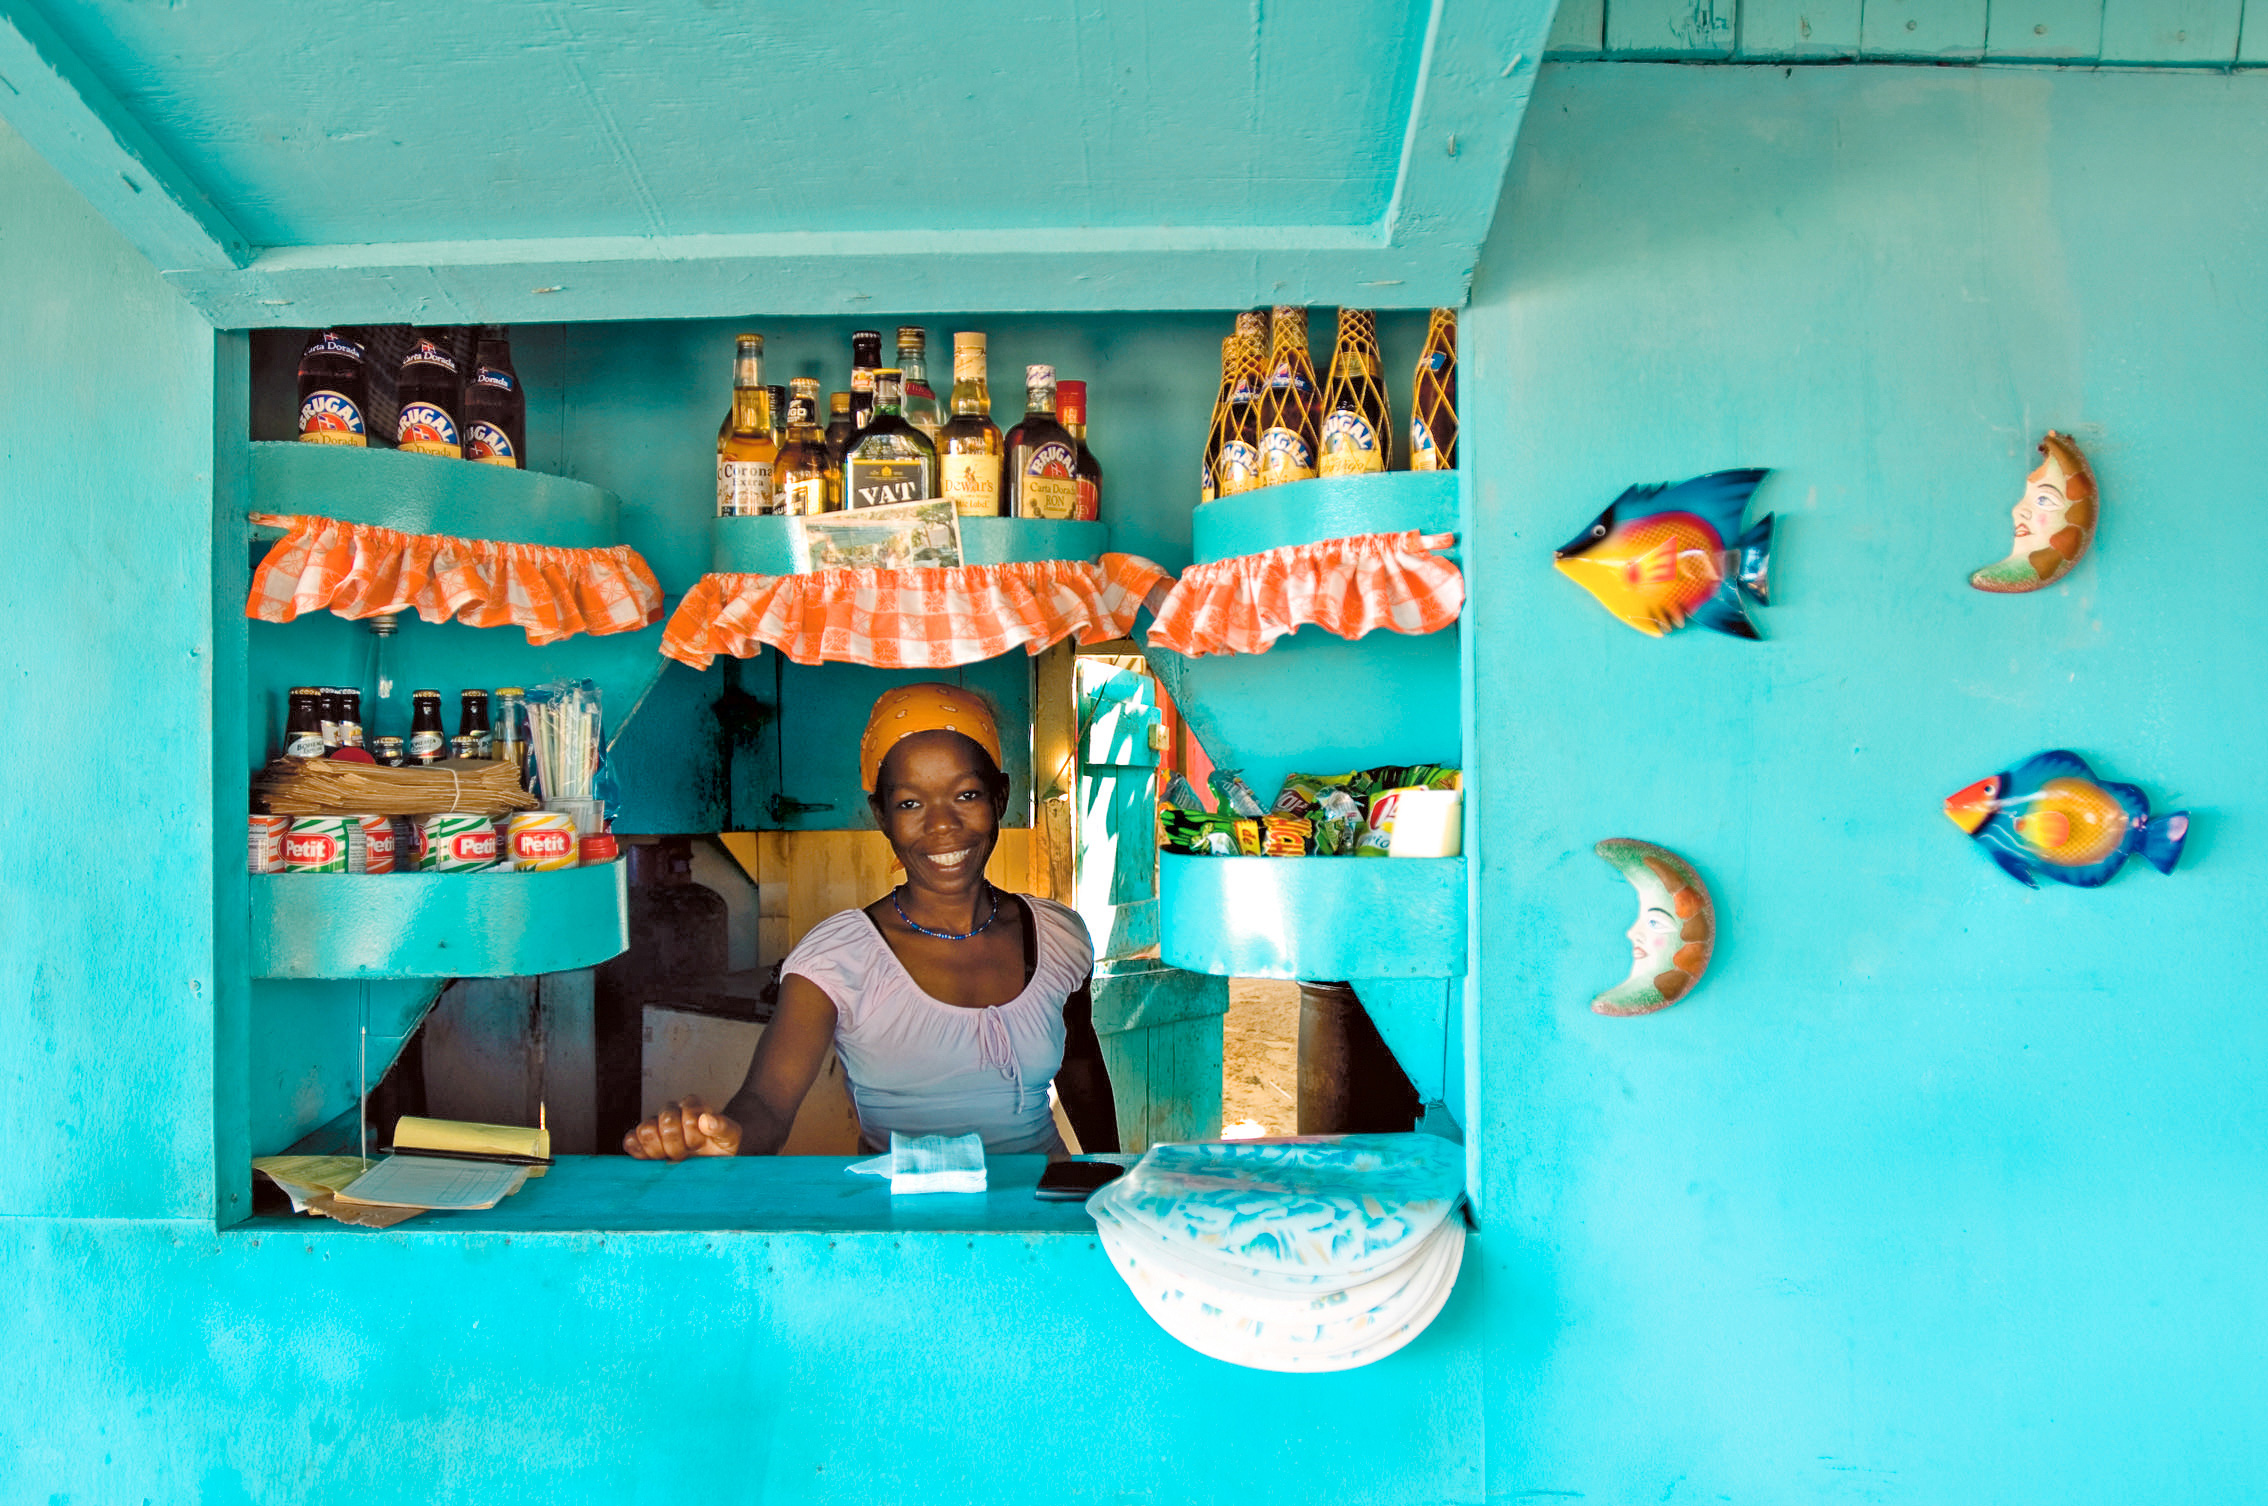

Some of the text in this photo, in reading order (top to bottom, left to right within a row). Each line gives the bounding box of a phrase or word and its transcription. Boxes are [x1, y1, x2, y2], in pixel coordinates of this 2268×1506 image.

[327, 342, 361, 359] Dorada
[423, 351, 456, 370] Dorada
[477, 374, 509, 388] Dorada
[299, 397, 361, 432] BRUGAL
[466, 425, 508, 457] UGAL
[724, 463, 774, 479] Corona
[1030, 446, 1076, 479] BRUGAL
[857, 481, 917, 506] VAT
[944, 479, 995, 493] Dewar's
[1030, 481, 1052, 493] Carta
[1045, 494, 1065, 508] RON
[286, 840, 326, 858] Petit
[520, 834, 565, 852] Petit
